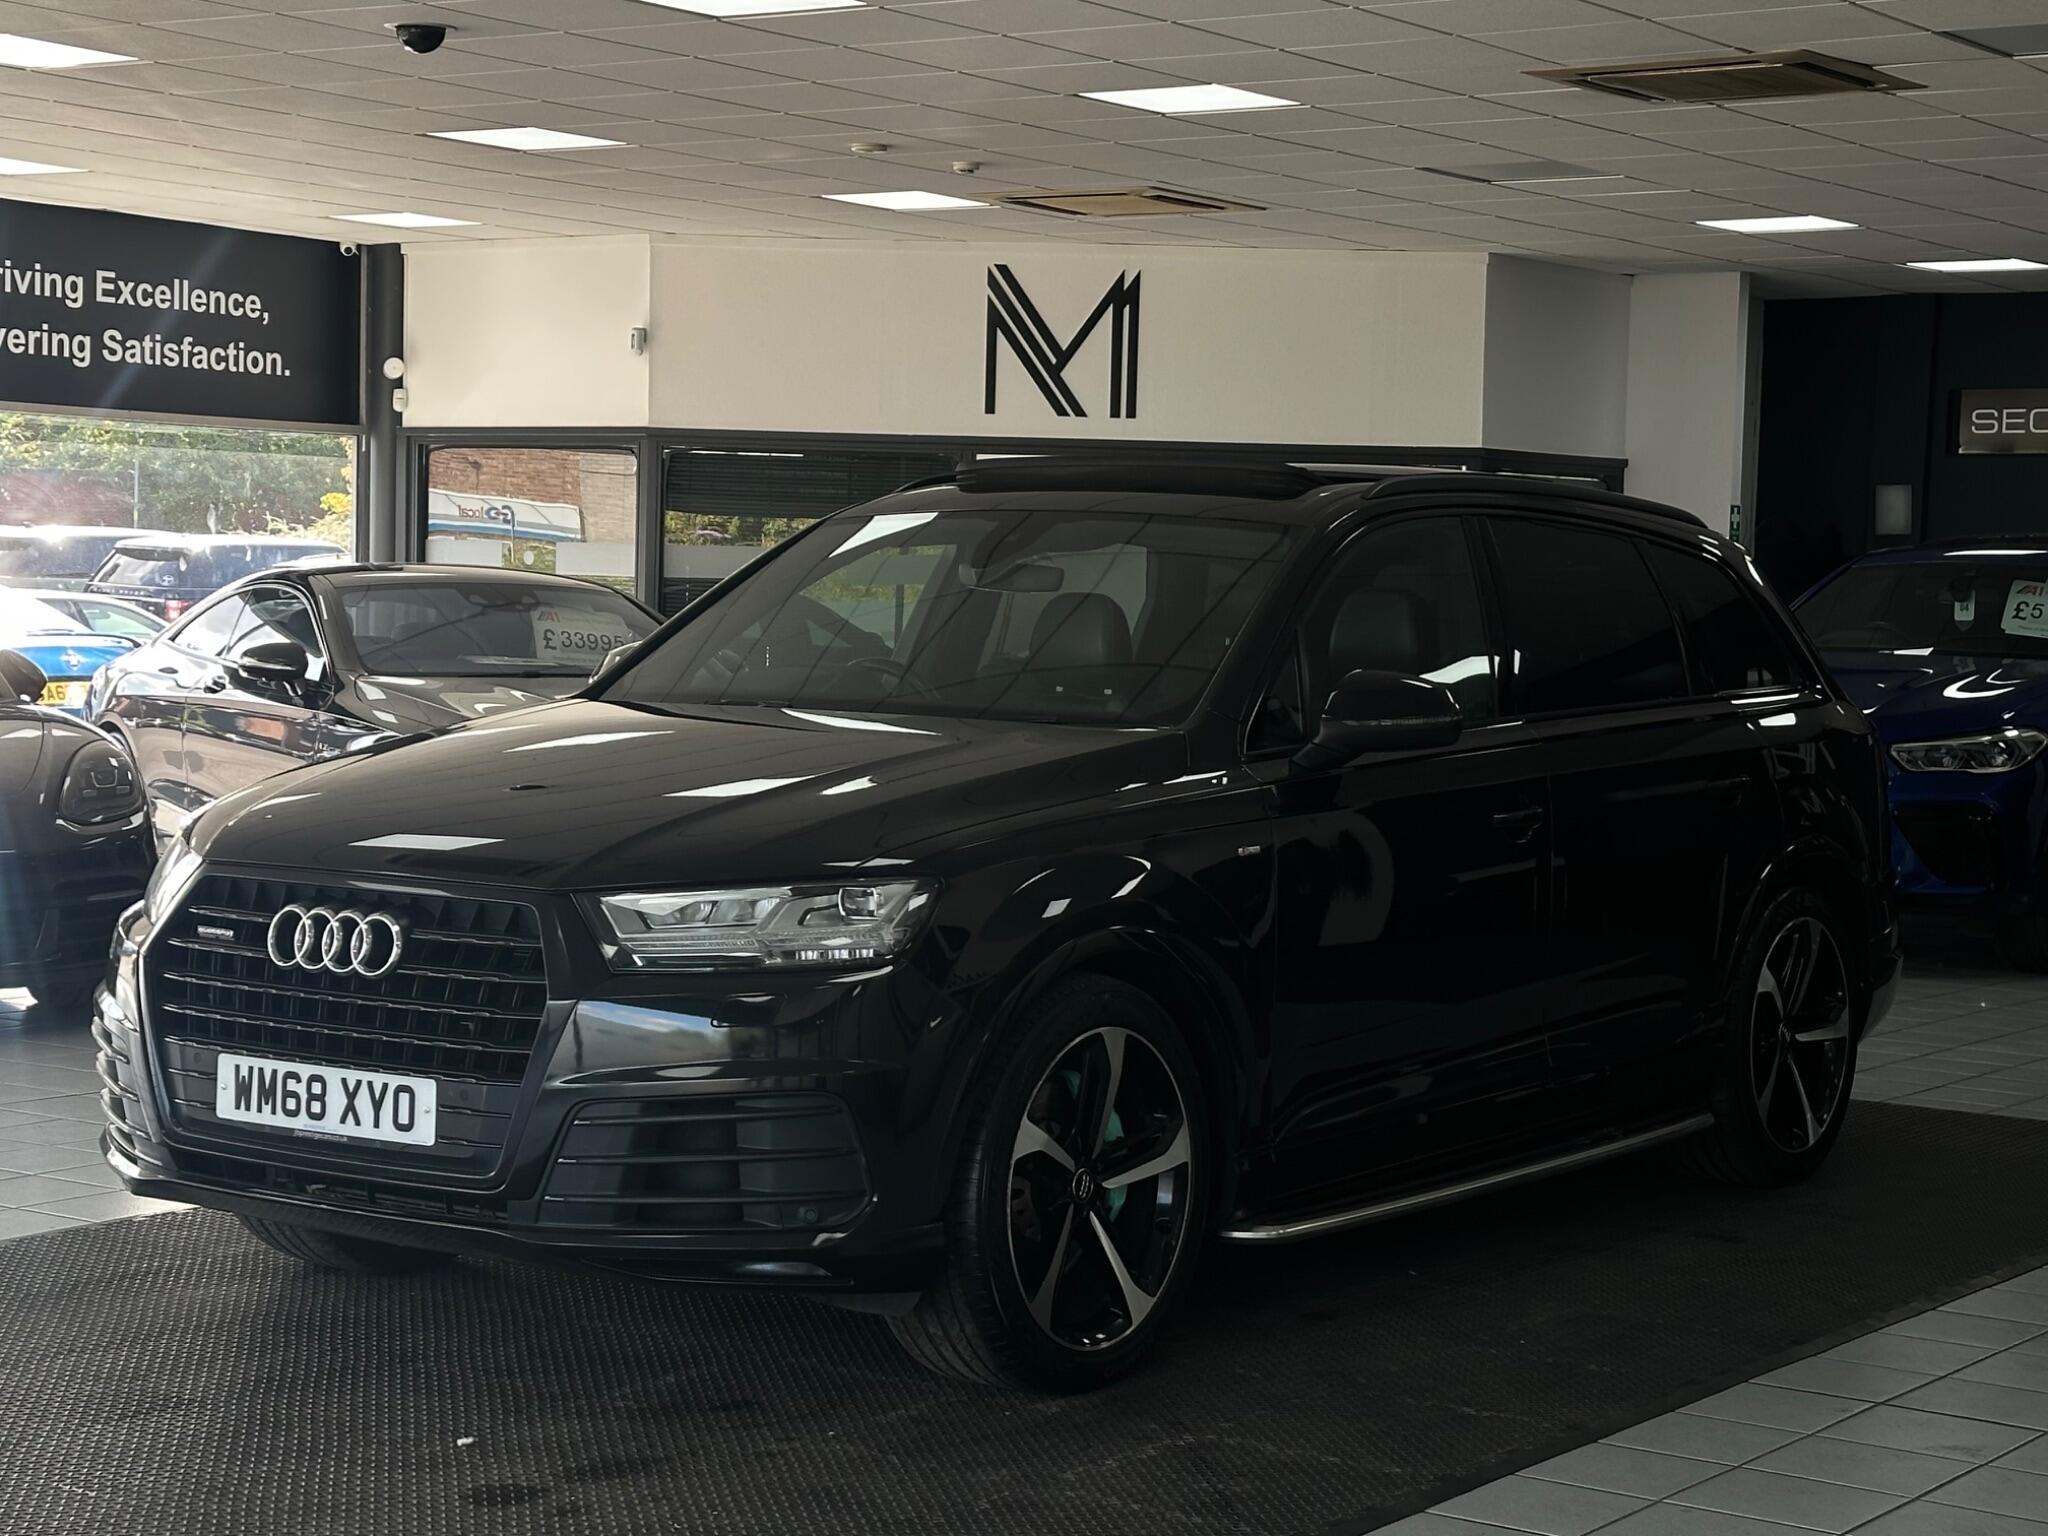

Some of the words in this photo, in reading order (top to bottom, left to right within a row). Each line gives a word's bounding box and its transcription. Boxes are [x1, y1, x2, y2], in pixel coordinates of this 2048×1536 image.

[95, 269, 270, 325] Excellence,
[102, 329, 291, 377] Satisfaction.
[543, 628, 626, 652] £33995
[234, 1063, 328, 1122] WM68
[339, 1077, 416, 1133] XYO
